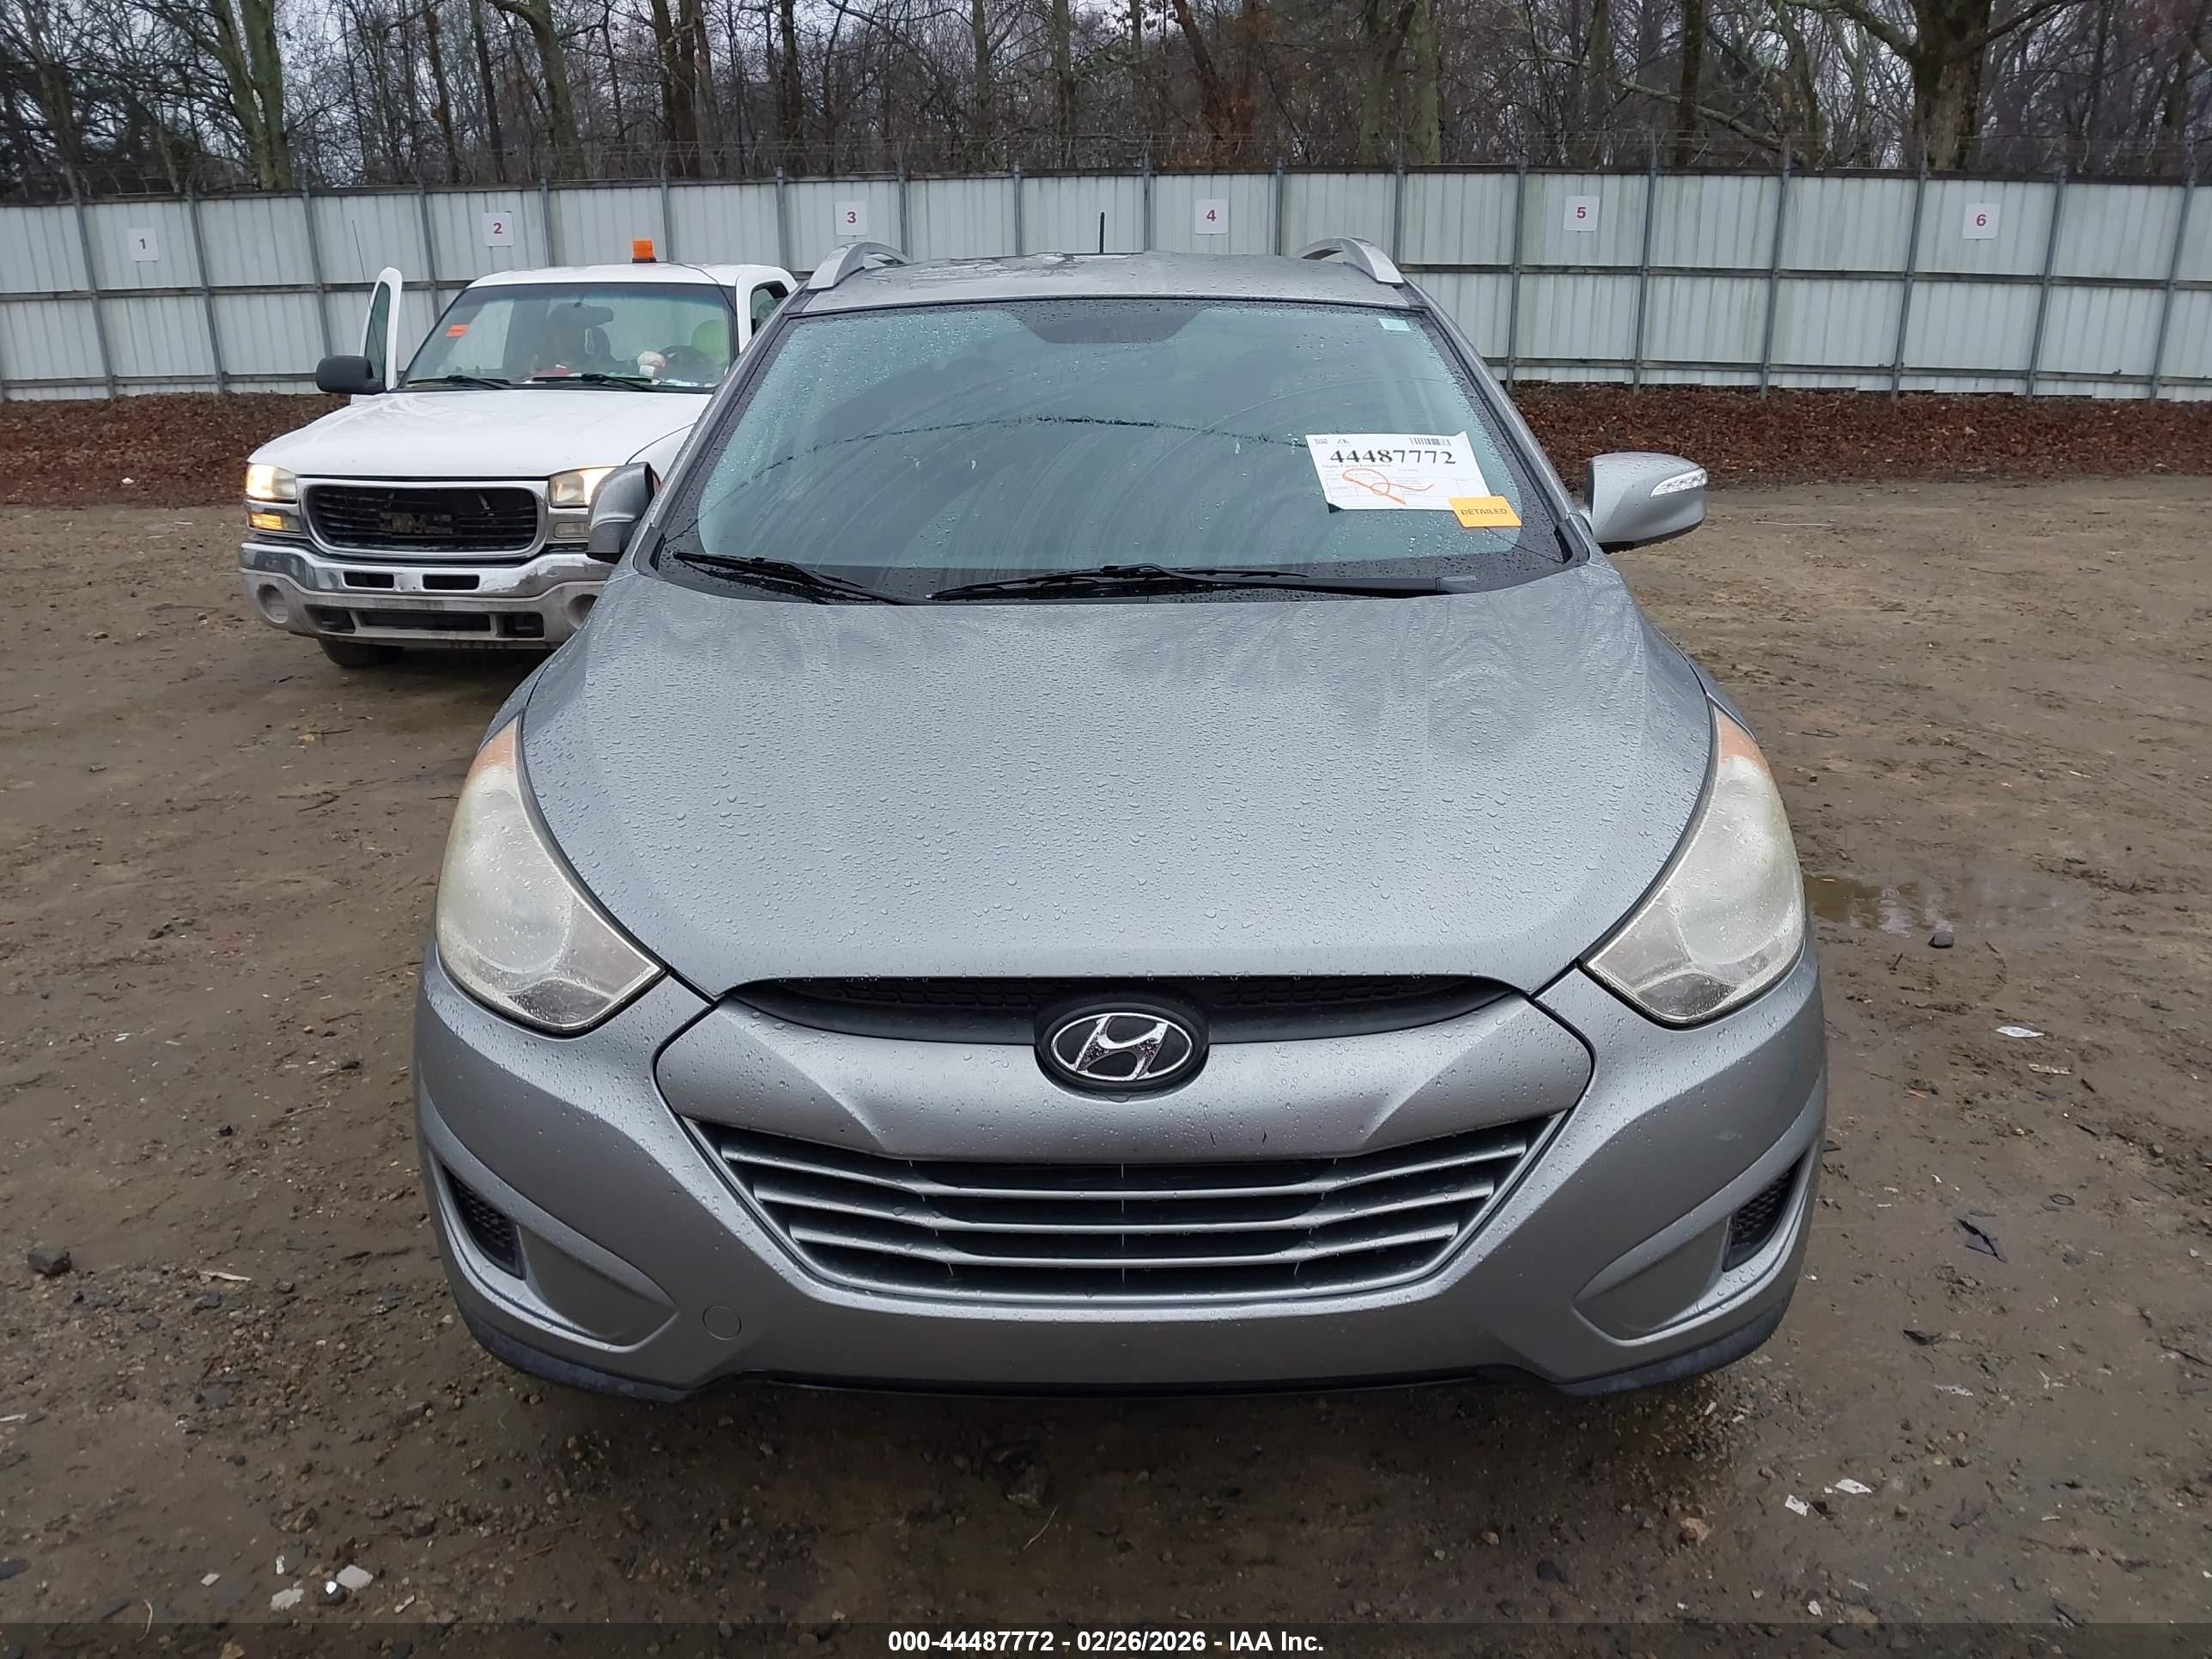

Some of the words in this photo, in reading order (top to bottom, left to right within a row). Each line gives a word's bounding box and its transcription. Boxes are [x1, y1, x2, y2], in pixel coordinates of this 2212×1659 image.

[847, 211, 857, 223] 3
[1206, 210, 1217, 222] 4
[1577, 206, 1587, 219] 5
[1976, 213, 1987, 227] 6
[493, 222, 503, 234] 2
[139, 238, 147, 250] 1
[1329, 449, 1456, 465] 44487772
